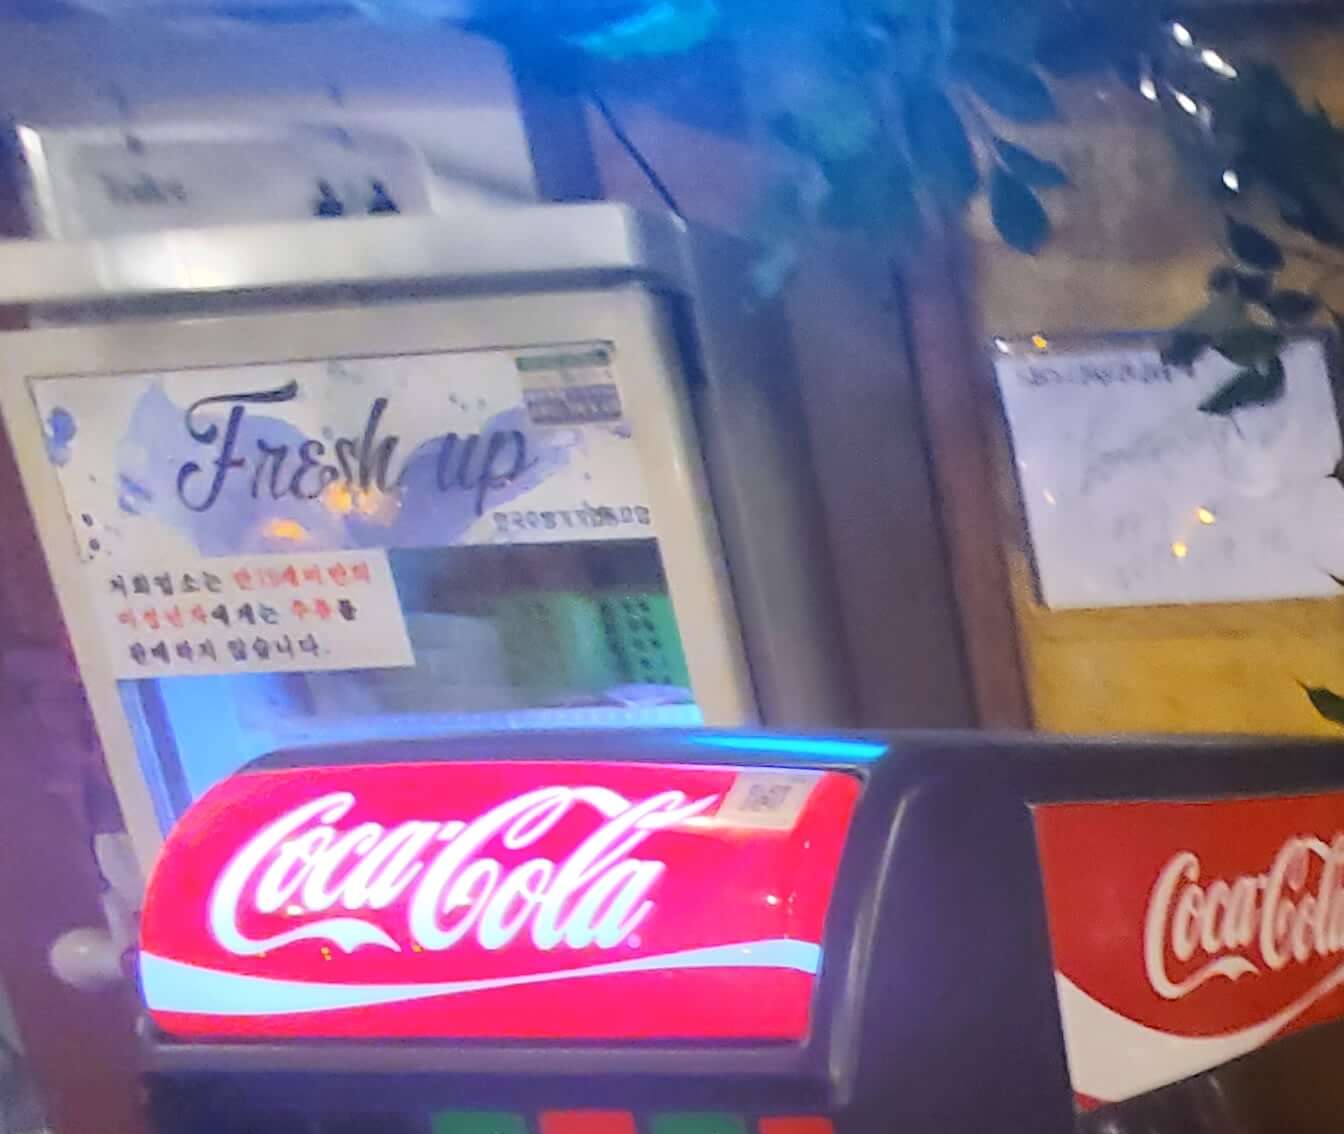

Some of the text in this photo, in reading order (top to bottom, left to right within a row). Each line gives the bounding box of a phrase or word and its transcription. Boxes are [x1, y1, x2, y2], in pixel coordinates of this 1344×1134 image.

[177, 379, 405, 513] Fresh
[436, 427, 540, 517] up
[209, 785, 718, 957] Coca-Cola
